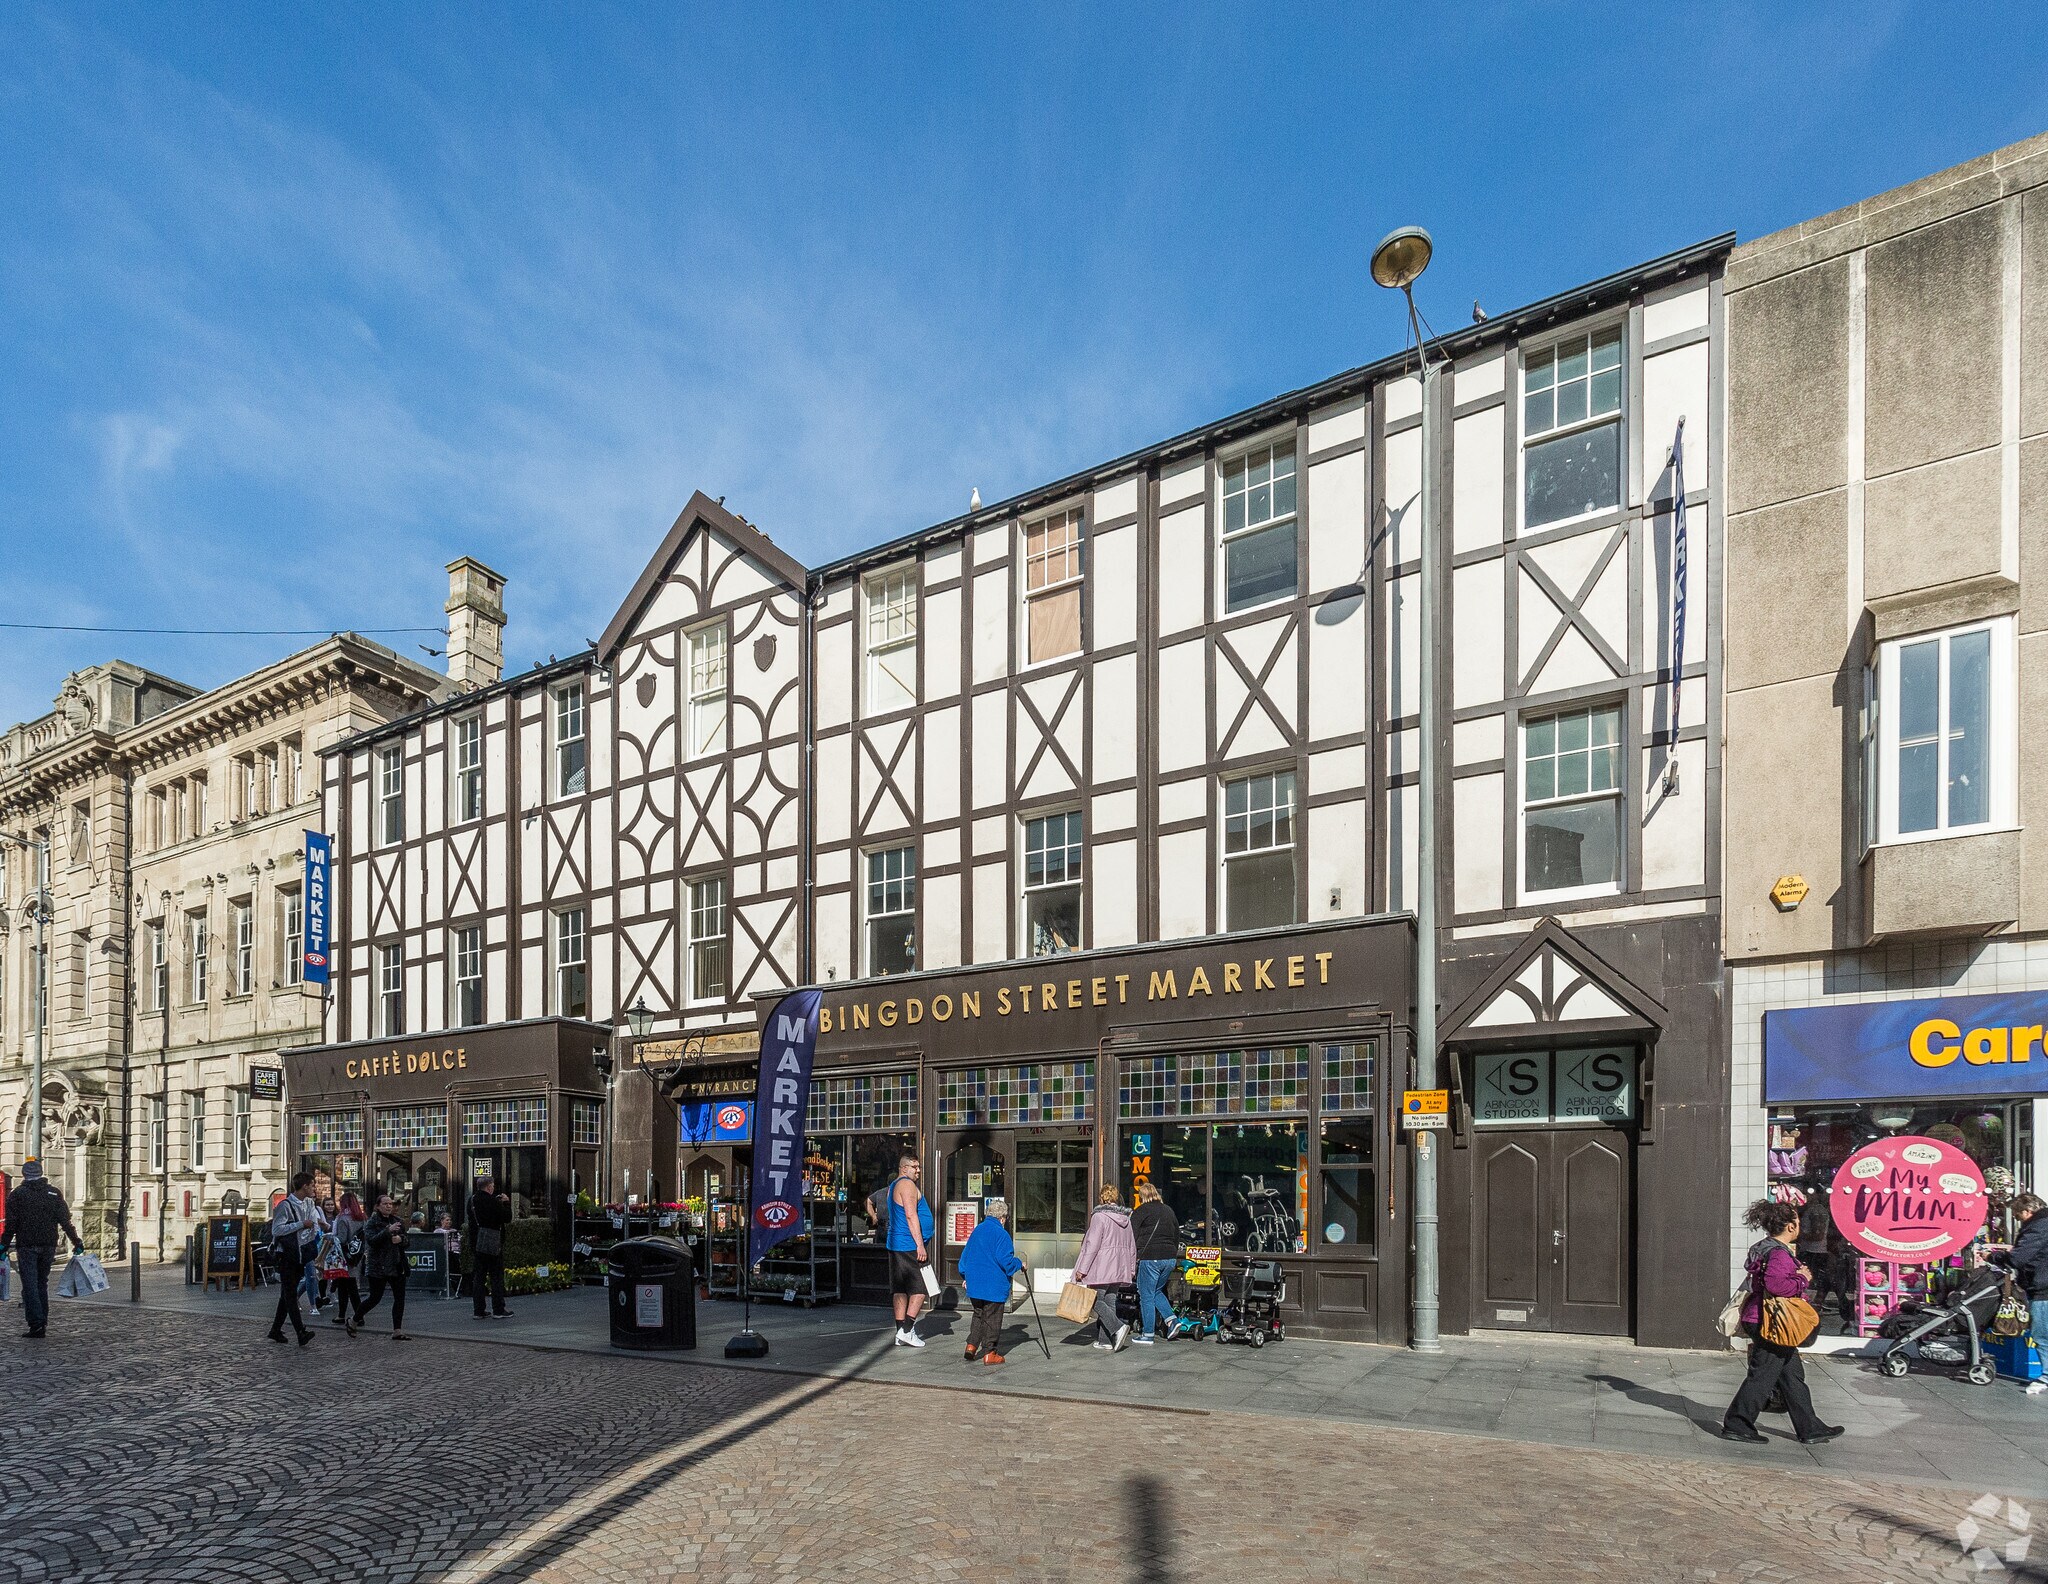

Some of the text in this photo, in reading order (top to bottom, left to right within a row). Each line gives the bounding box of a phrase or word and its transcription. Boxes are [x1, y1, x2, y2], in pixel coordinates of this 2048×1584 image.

[309, 846, 325, 951] MARKET
[820, 952, 1334, 1033] BINGDON STREET MARKET
[1909, 1018, 2048, 1068] Car
[346, 1048, 467, 1079] CAFFÈ DOLCE
[690, 1080, 757, 1095] ENTRANCE
[768, 1014, 806, 1197] MARKET
[1484, 1098, 1540, 1110] ABINGDON
[1566, 1095, 1625, 1107] ABINGDON
[1484, 1108, 1540, 1119] STUDIOS
[1566, 1105, 1624, 1117] STUDIOS
[806, 1140, 821, 1152] The
[1907, 1150, 1936, 1161] AMAZING
[1890, 1167, 1929, 1192] My
[1193, 1268, 1210, 1276] £799
